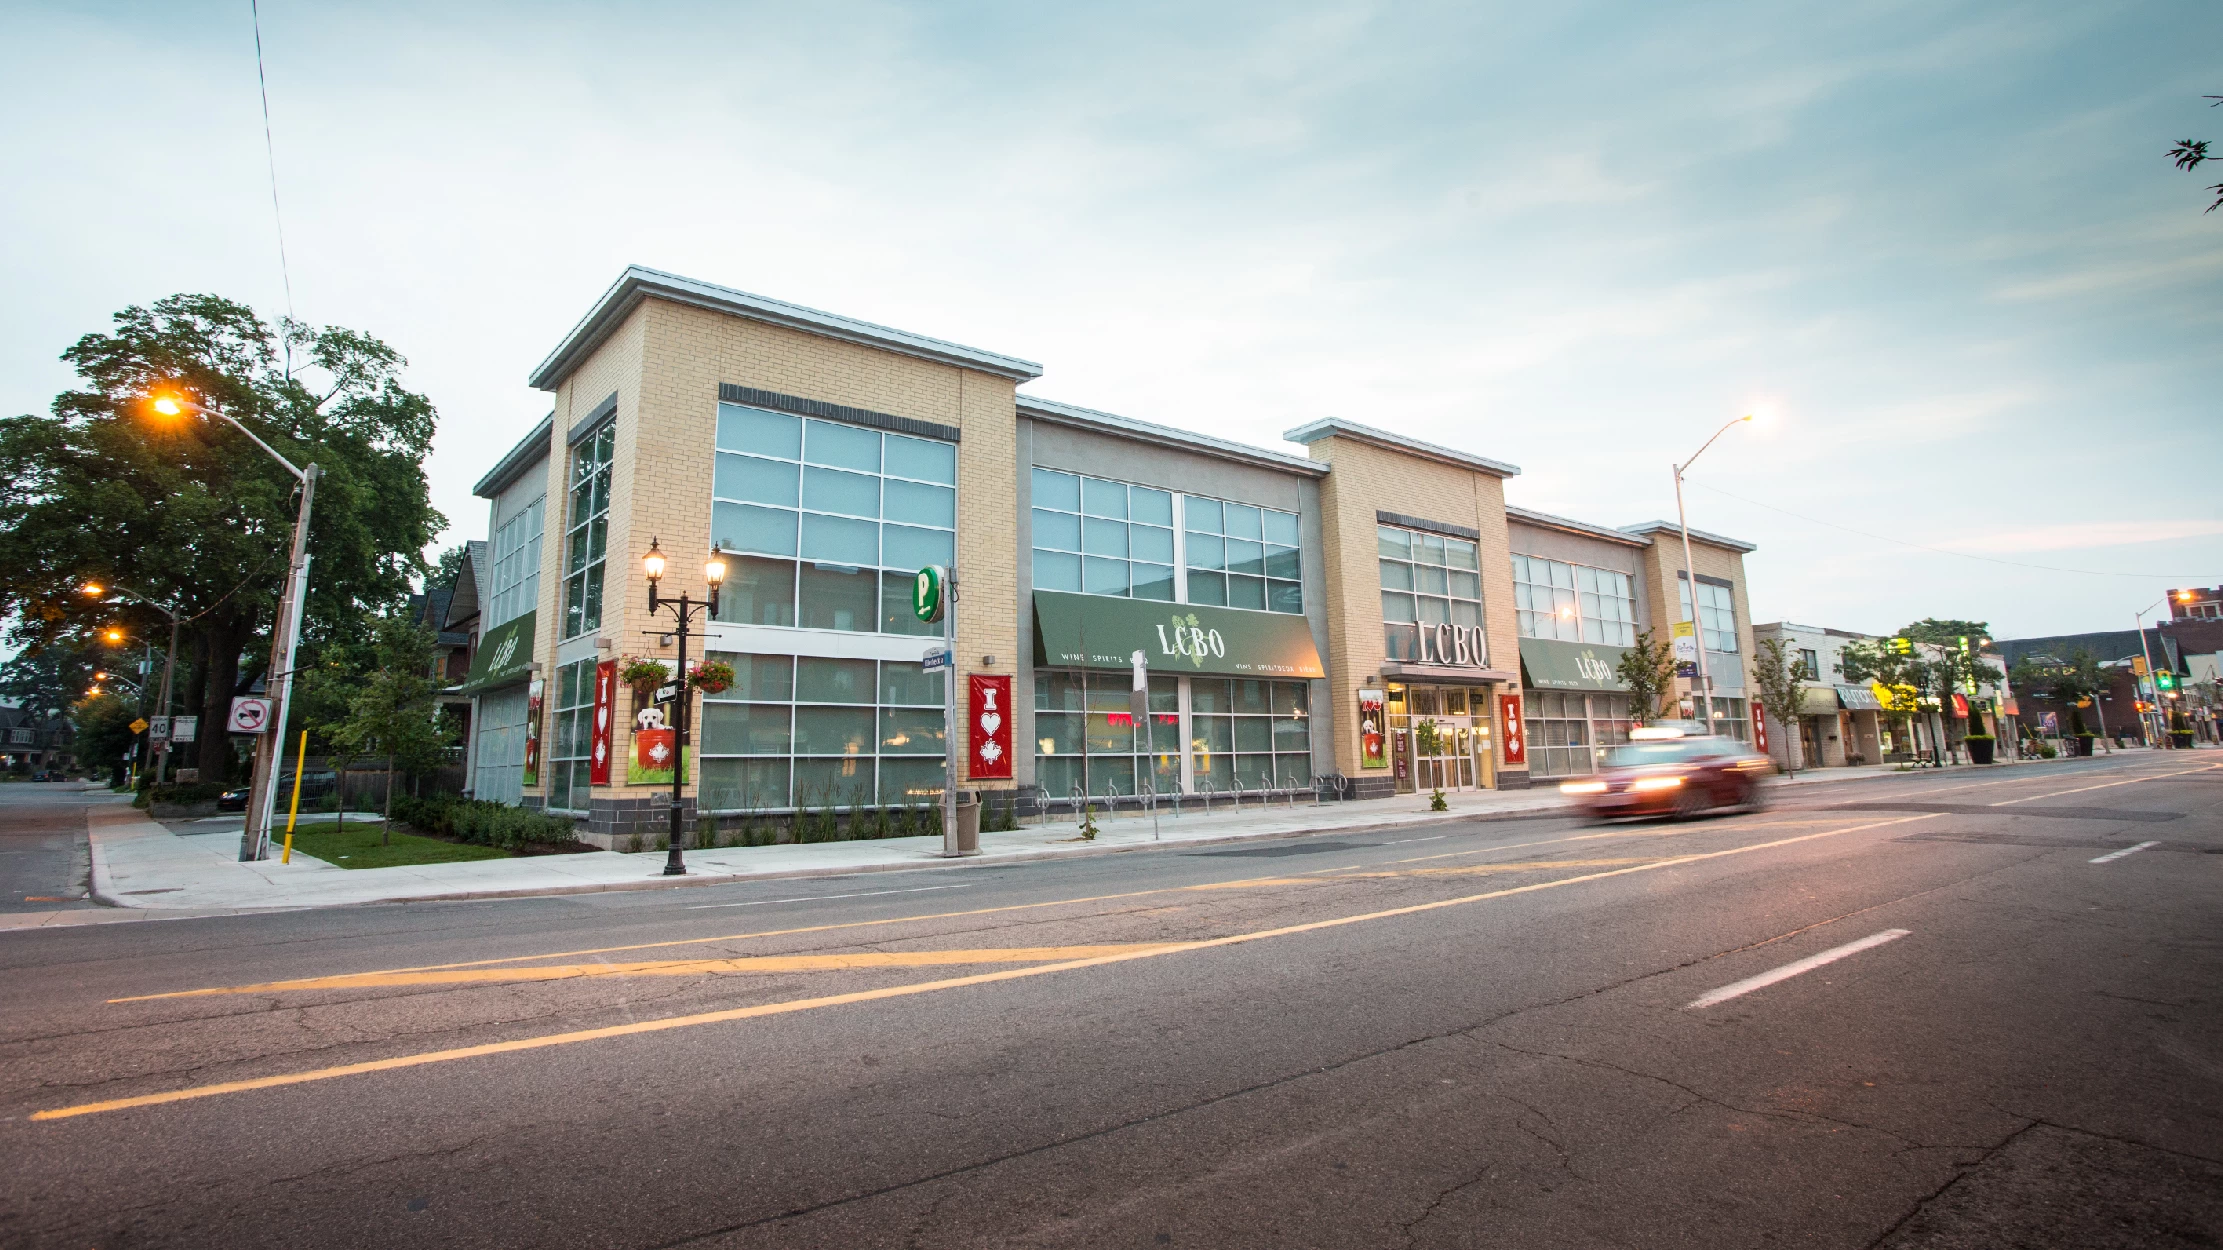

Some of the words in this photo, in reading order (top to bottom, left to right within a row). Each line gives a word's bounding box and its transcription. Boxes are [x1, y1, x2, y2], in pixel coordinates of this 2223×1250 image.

[918, 573, 929, 606] P
[1156, 624, 1225, 659] LCBO
[1414, 620, 1487, 666] LCBO
[1061, 653, 1084, 661] WINE
[1092, 655, 1123, 663] SPIRITS
[1575, 658, 1611, 680] LCBO
[983, 688, 997, 711] I
[1507, 704, 1515, 718] I
[152, 723, 166, 734] 40
